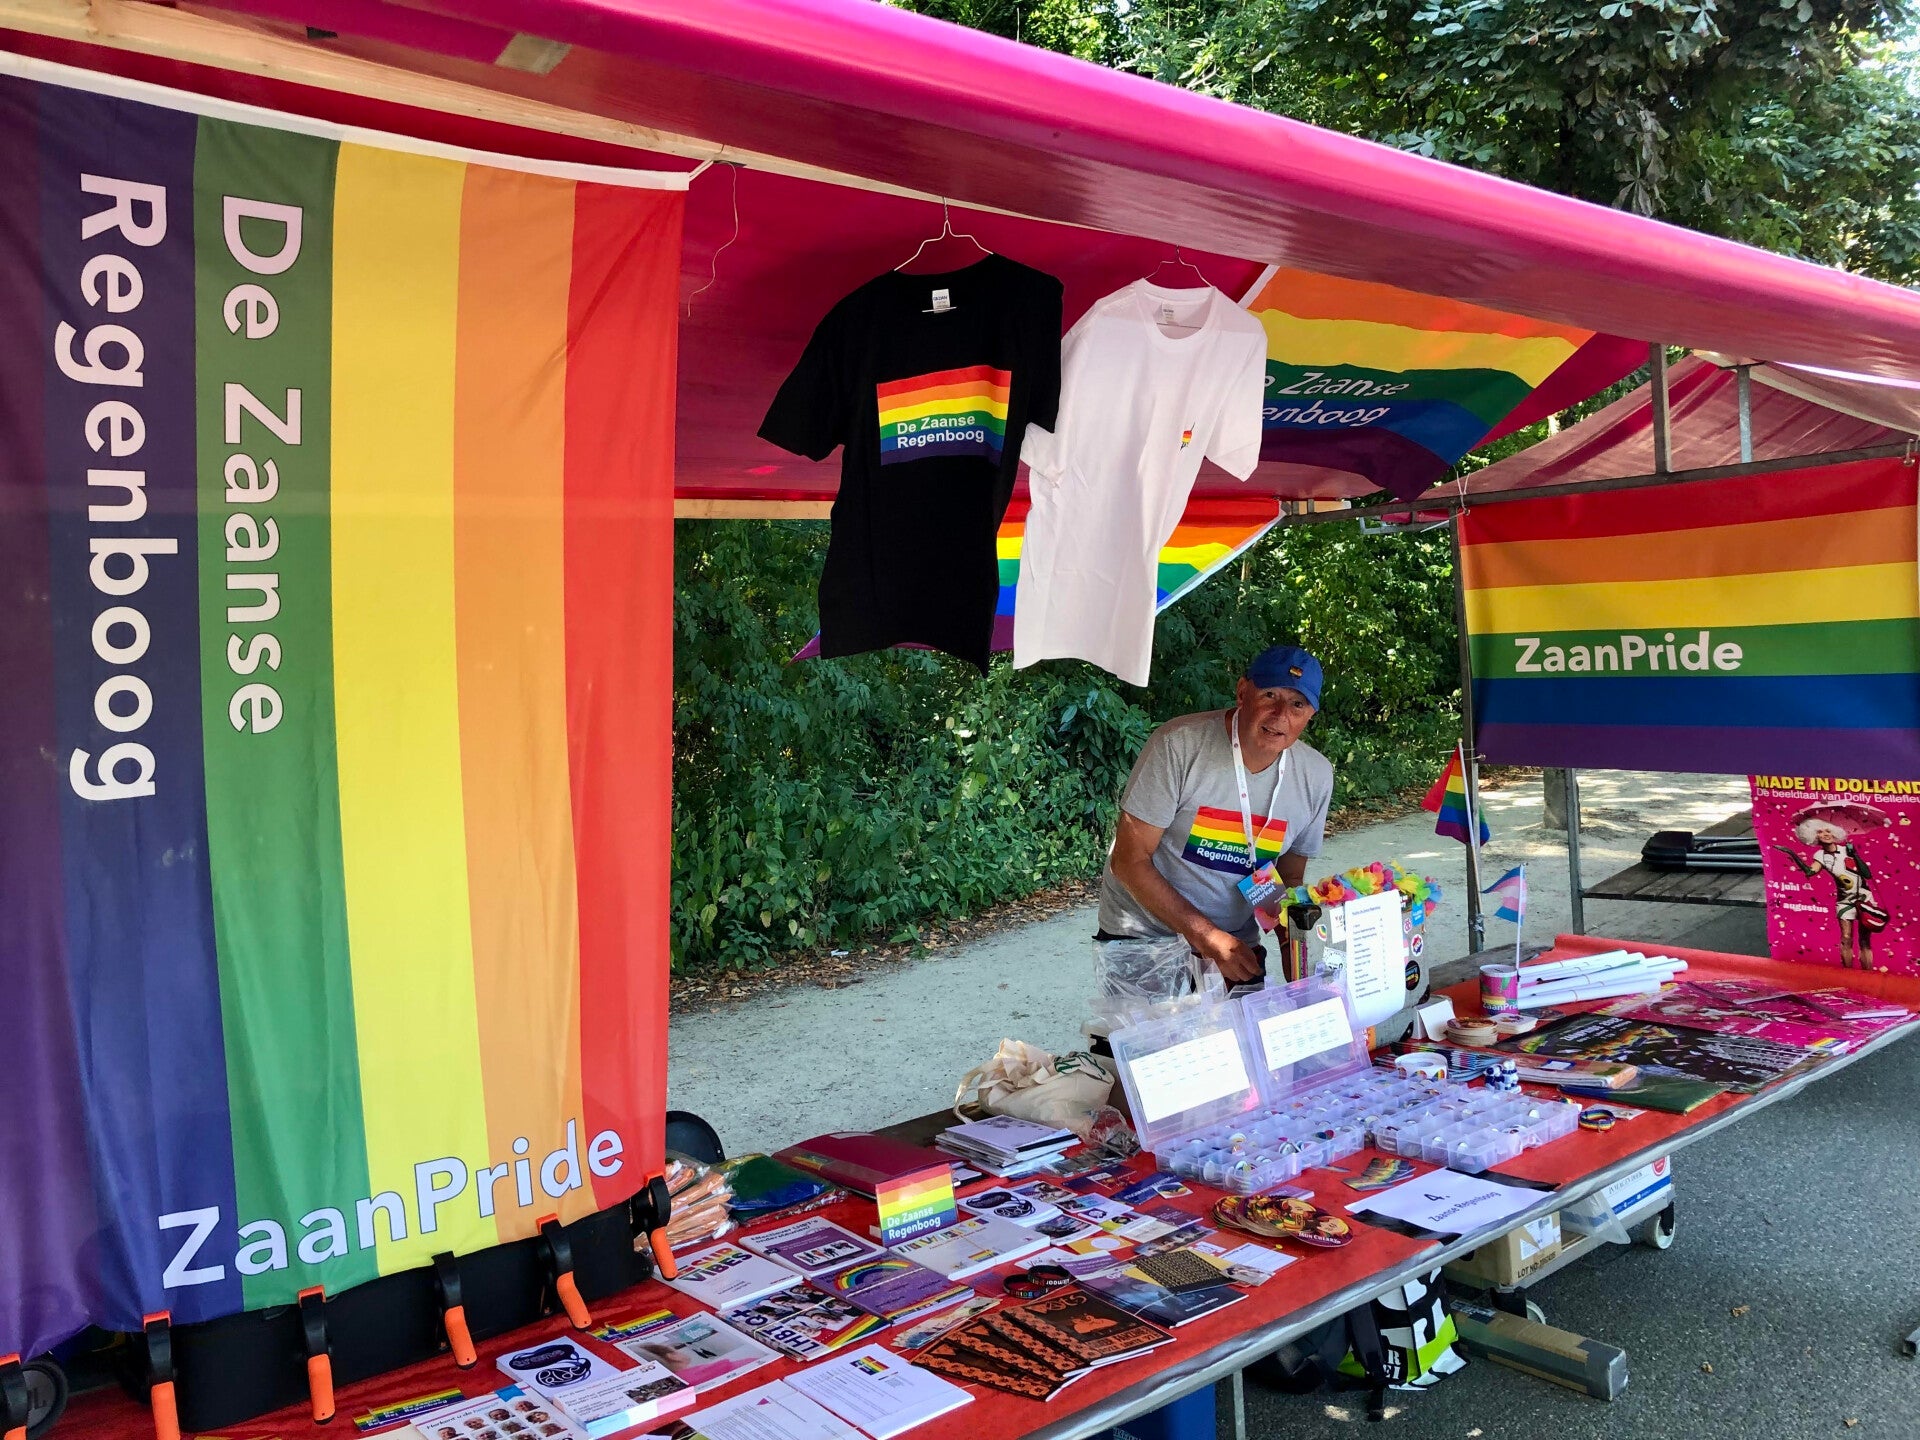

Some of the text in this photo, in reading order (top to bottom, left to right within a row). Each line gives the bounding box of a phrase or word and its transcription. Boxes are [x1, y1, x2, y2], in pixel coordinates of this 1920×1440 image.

[1277, 372, 1410, 397] Zaanse
[1262, 400, 1391, 427] enboog
[897, 416, 976, 435] De Zaanse
[897, 429, 985, 449] Regenboog
[222, 194, 304, 735] De Zaanse
[55, 172, 179, 802] Regenboog
[1514, 631, 1744, 673] ZaanPride
[1756, 775, 1920, 794] MADE IN DOLLAND
[1757, 787, 1769, 797] De
[1772, 789, 1819, 801] beeldtaal
[1821, 792, 1842, 802] van
[1844, 792, 1871, 804] Dolly
[1200, 838, 1250, 855] De Zaanse
[1196, 847, 1254, 869] Regenboog
[1248, 877, 1276, 900] rainbow
[1251, 885, 1277, 906] market
[1781, 881, 1800, 892] juni
[1783, 902, 1829, 914] augustus
[157, 1118, 625, 1290] ZaanPride
[887, 1206, 934, 1228] De Zaanse
[888, 1216, 941, 1240] Regenboog
[678, 1252, 753, 1282] VIBES
